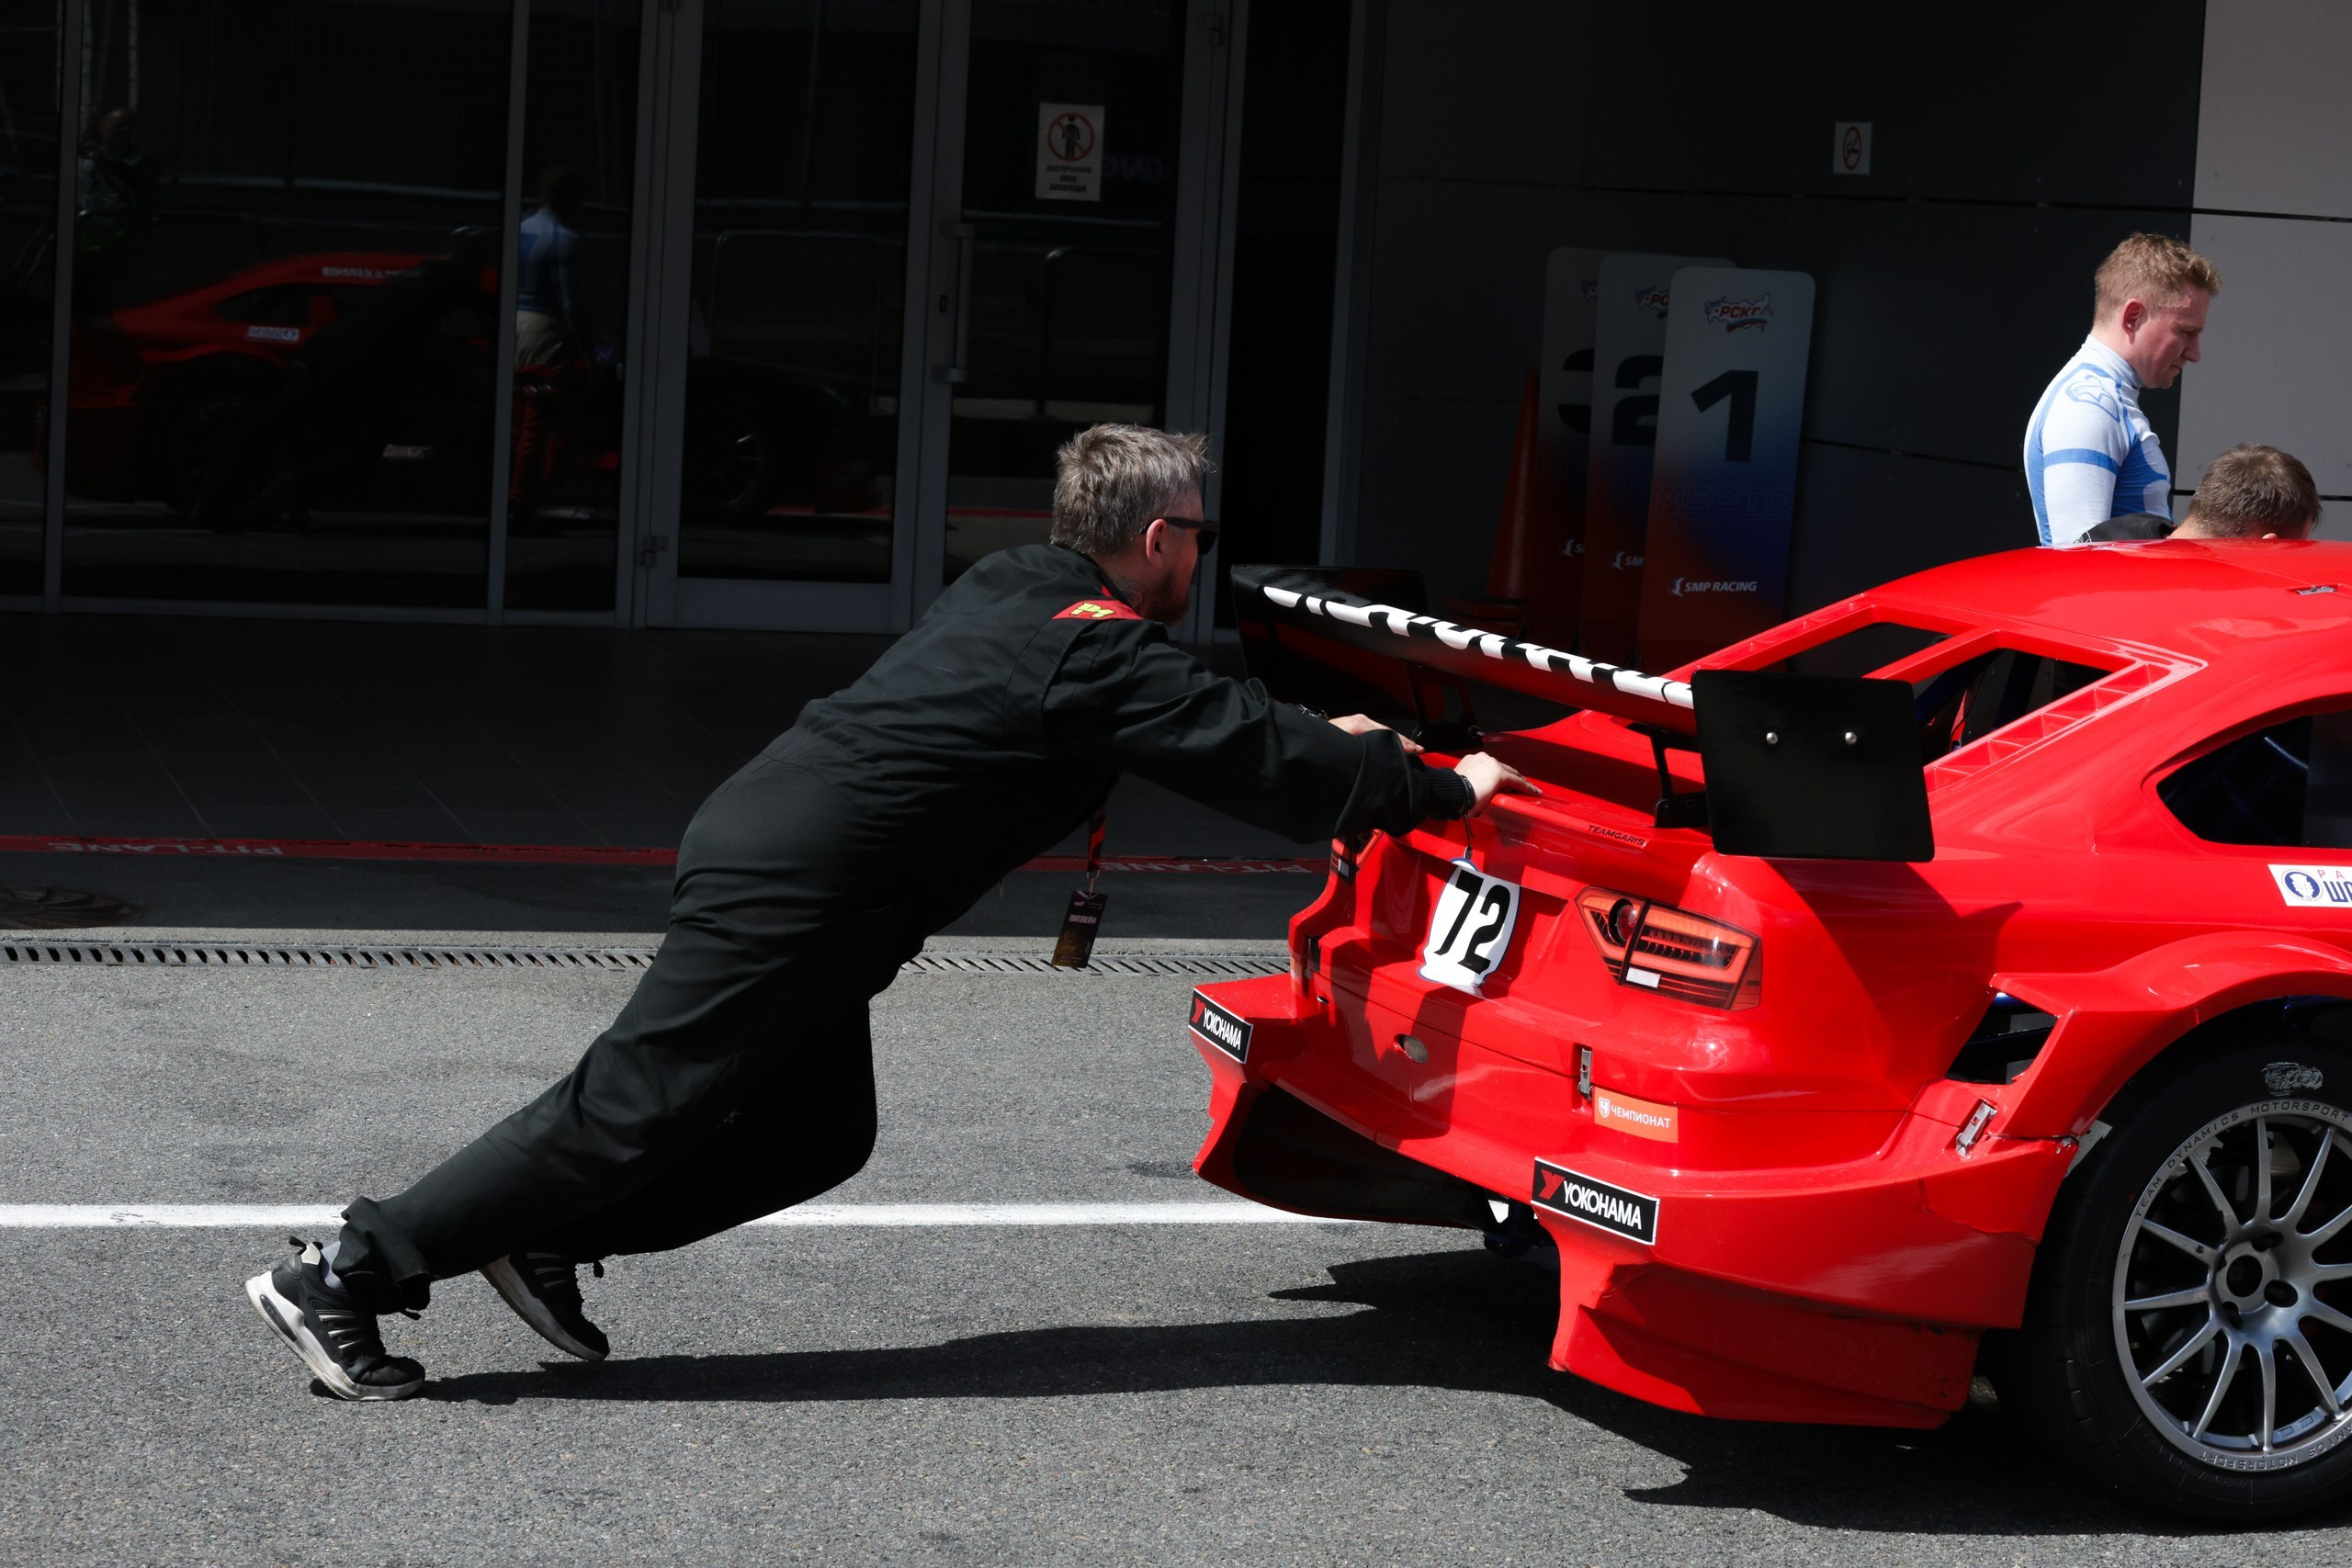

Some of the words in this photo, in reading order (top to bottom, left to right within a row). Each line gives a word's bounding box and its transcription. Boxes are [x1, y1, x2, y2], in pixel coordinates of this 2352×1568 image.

[1690, 370, 1758, 462] 1
[1685, 581, 1711, 592] SMP
[1713, 581, 1758, 592] RACING
[49, 841, 284, 854] PIT-LANE
[1589, 825, 1645, 845] TEAMGARIS
[1433, 869, 1510, 975] 72
[1204, 1008, 1242, 1050] YOKOHAMA
[1611, 1105, 1671, 1128] ЧЕМПИОНАТ
[2134, 1177, 2163, 1218] TEAM
[2167, 1112, 2240, 1170] DYNAMICS
[2251, 1101, 2349, 1122] MOTORSPORT
[1564, 1180, 1643, 1231] YOKOHAMA
[2199, 1450, 2299, 1471] MOTORSPORT
